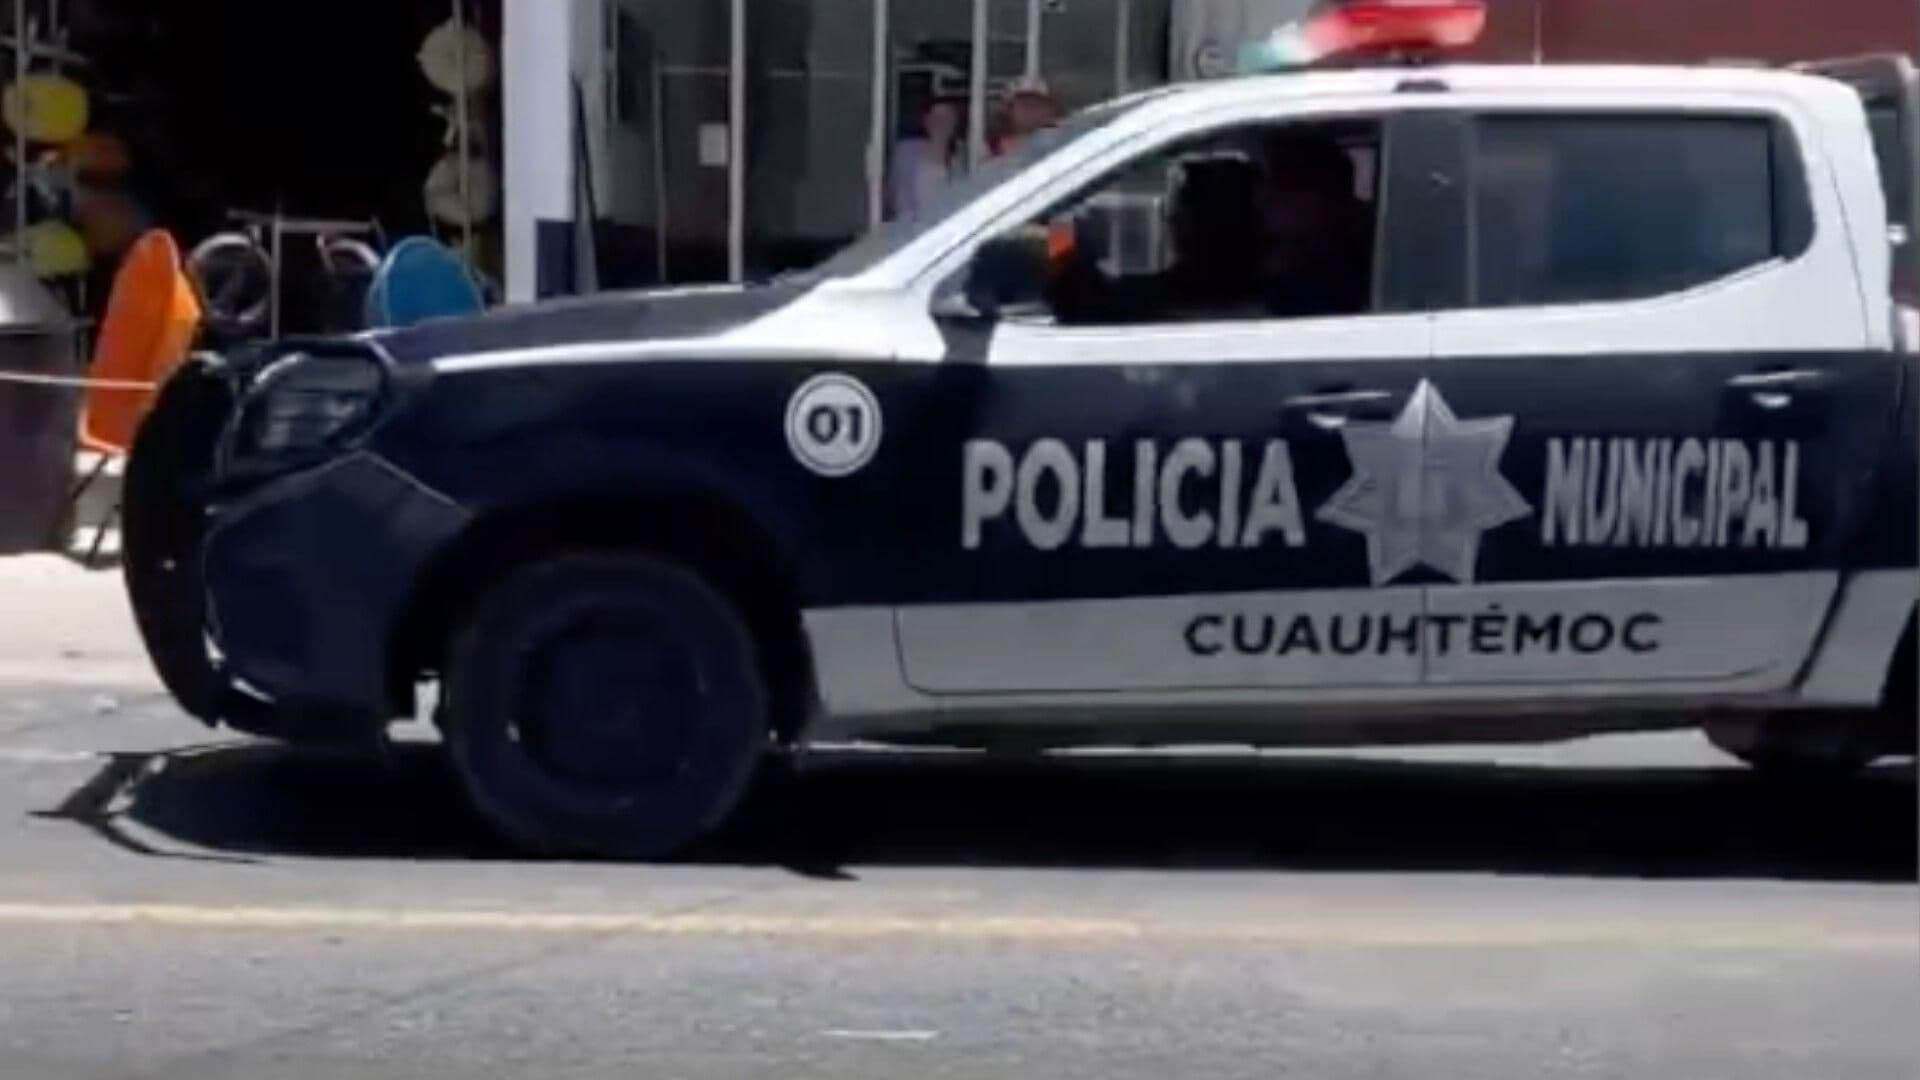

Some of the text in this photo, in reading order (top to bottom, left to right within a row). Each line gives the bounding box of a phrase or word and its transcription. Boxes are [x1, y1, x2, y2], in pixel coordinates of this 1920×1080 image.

[807, 405, 862, 445] 01
[961, 437, 1808, 550] POLICIA MUNICIPAL
[1183, 603, 1663, 656] CUAUHTÉMOC
